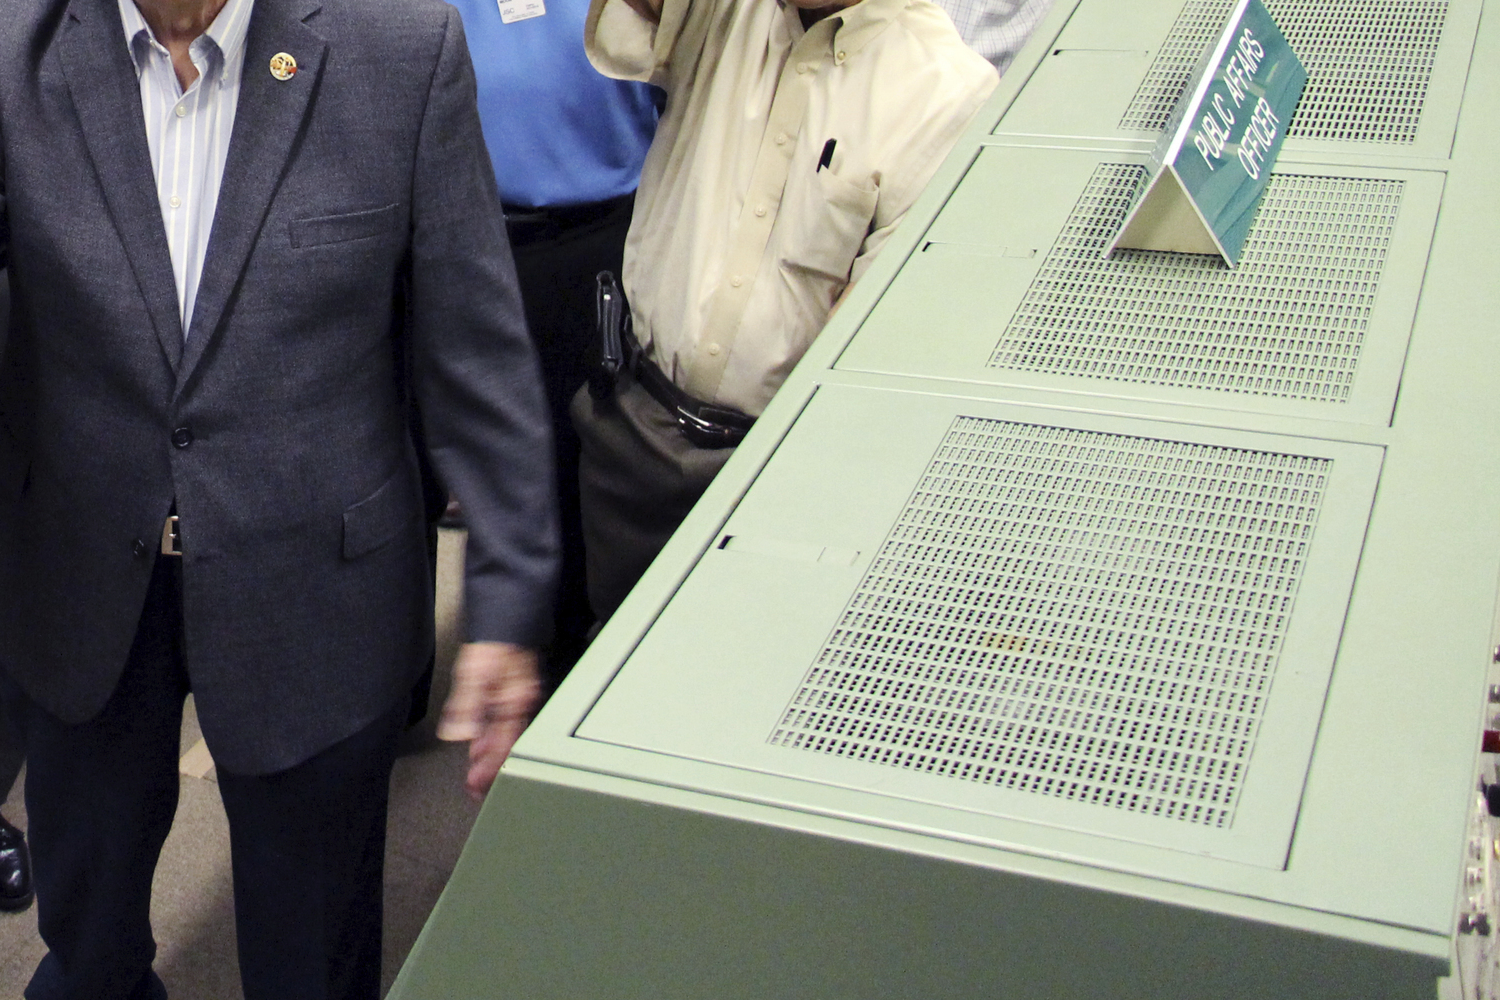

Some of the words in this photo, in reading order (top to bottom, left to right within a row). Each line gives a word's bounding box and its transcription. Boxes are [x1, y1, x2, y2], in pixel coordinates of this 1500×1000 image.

[1193, 92, 1236, 171] PUBLIC
[1223, 27, 1265, 109] AFFAIRS
[1237, 96, 1280, 181] OFFICER
